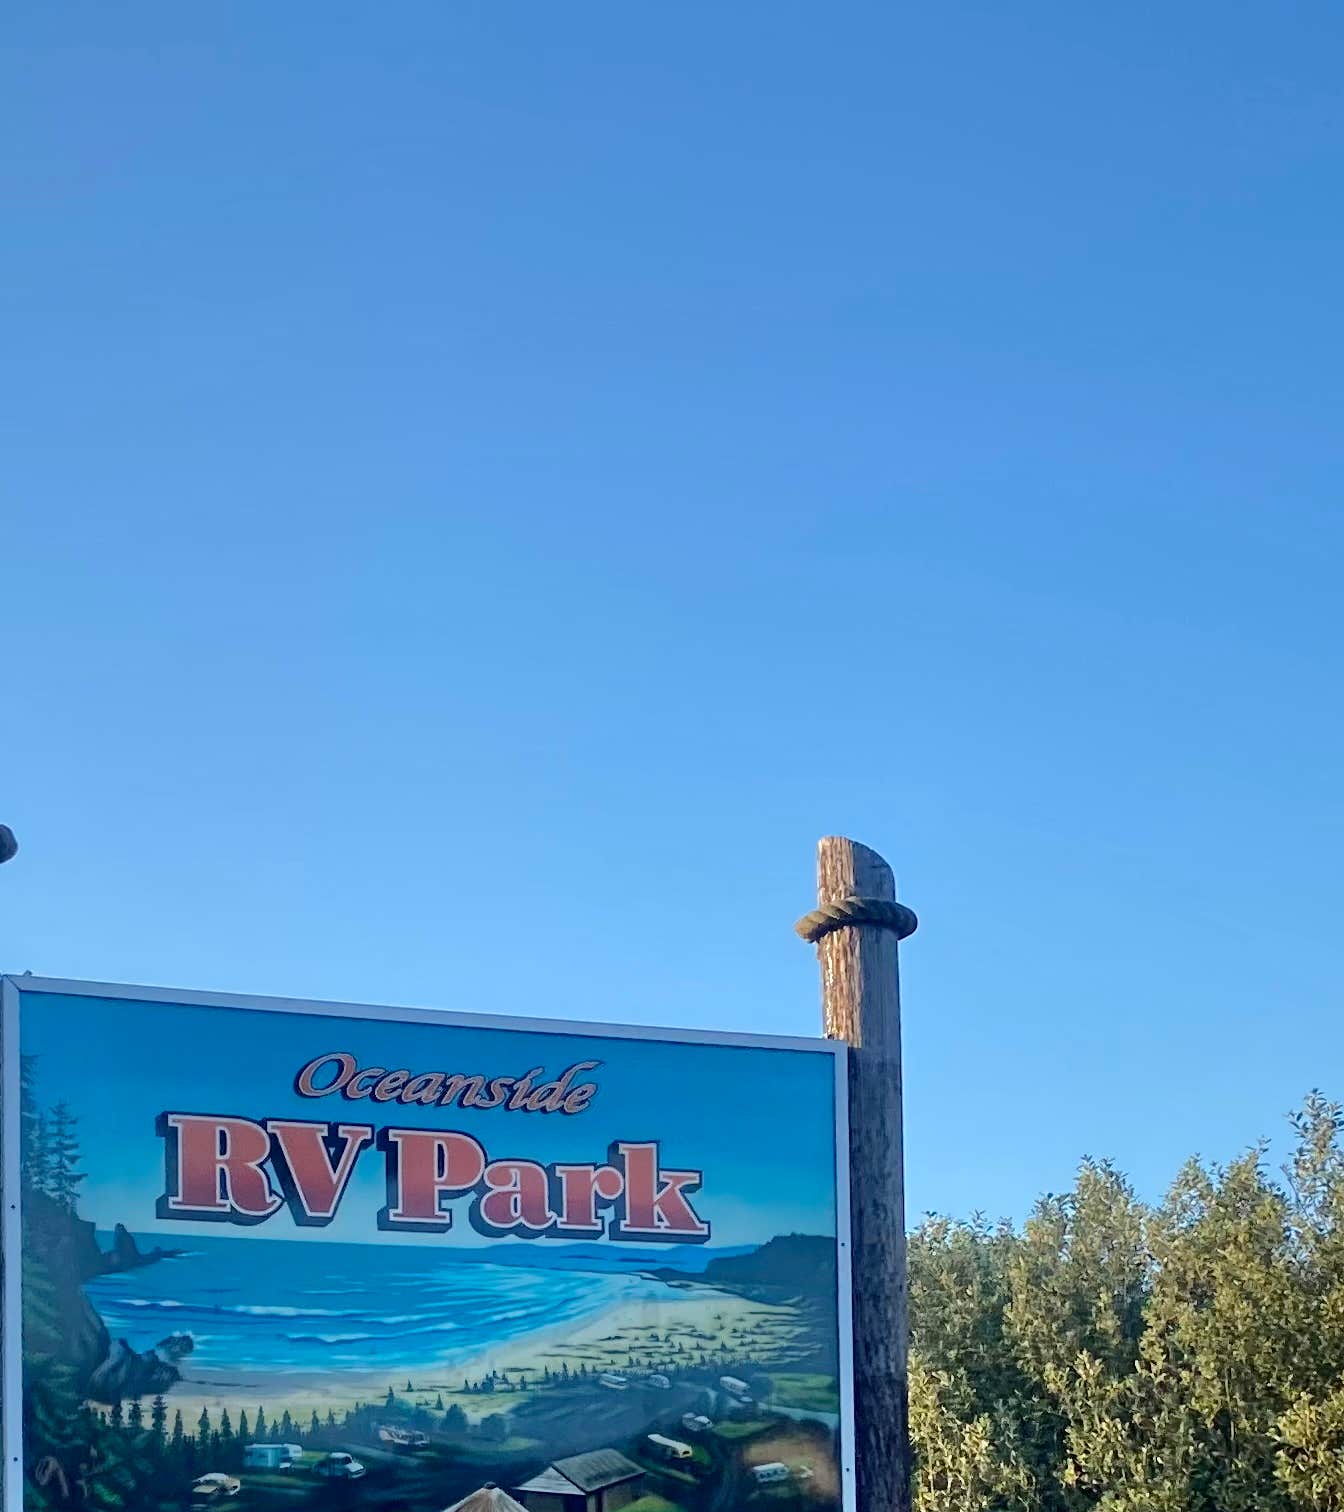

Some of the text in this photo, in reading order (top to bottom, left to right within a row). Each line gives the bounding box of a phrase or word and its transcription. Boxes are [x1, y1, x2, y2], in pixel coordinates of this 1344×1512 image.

[296, 1051, 603, 1114] Oceanside
[160, 1112, 710, 1242] RV Park
